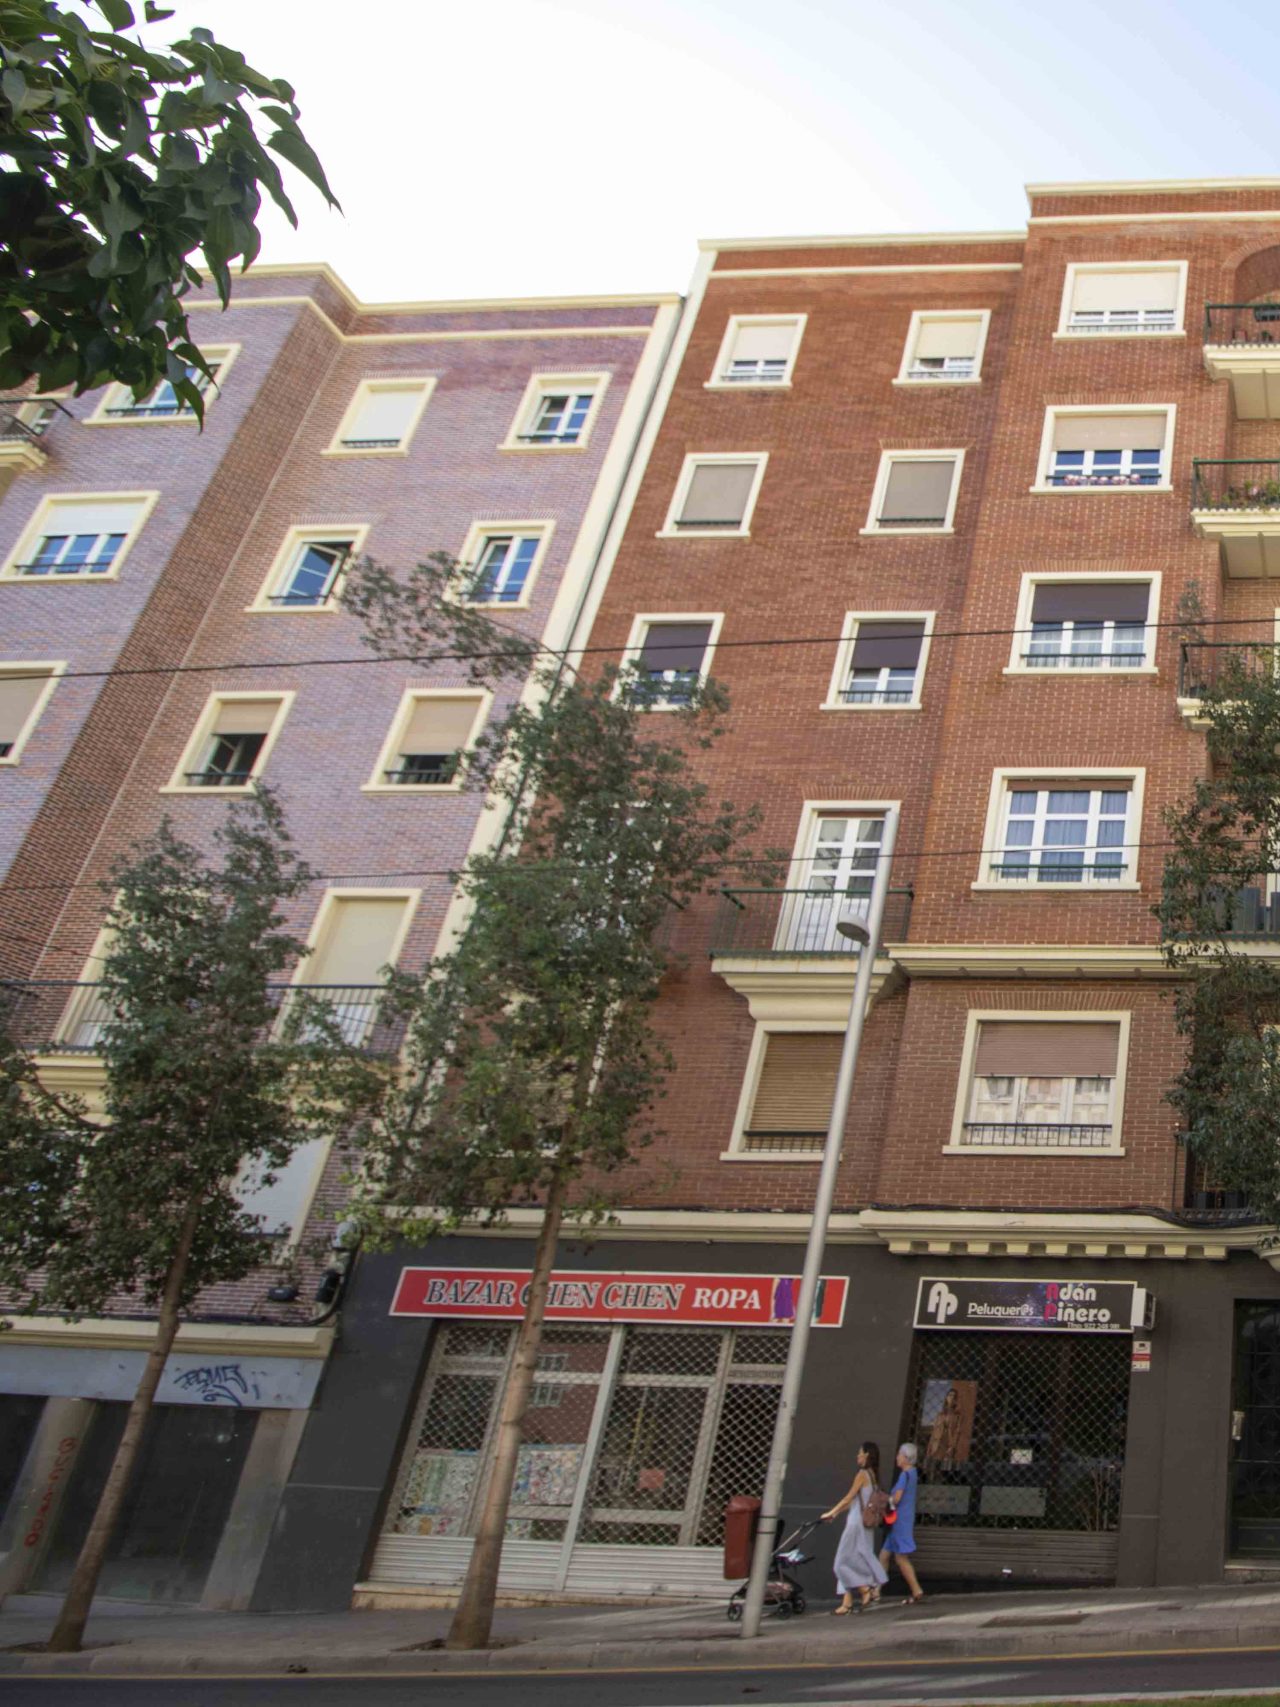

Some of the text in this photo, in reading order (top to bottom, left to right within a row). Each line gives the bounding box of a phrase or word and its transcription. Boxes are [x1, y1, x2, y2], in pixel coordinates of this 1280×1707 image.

[423, 1279, 516, 1307] BAZAR
[602, 1281, 685, 1311] CHEN
[693, 1287, 762, 1310] ROPA
[1046, 1282, 1097, 1301] Adán
[967, 1302, 1034, 1317] Peluquer@s
[1044, 1301, 1111, 1323] Piñero
